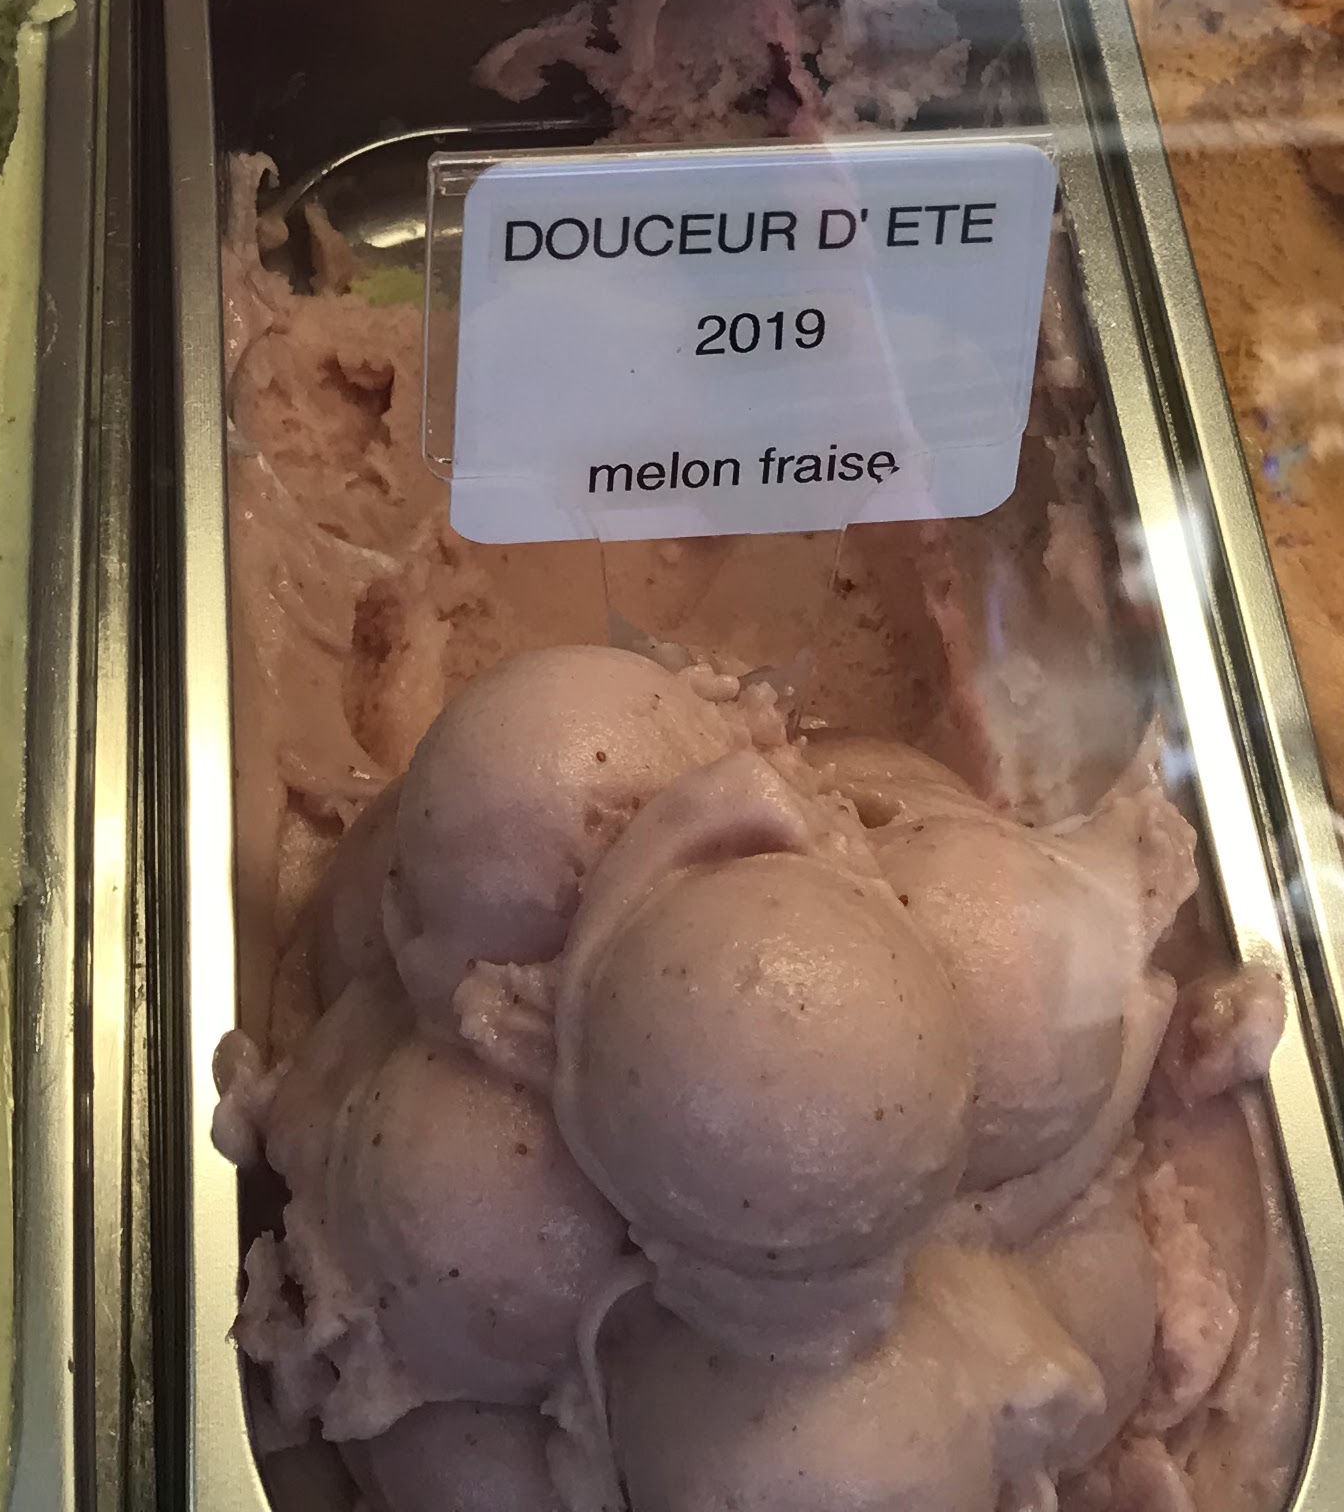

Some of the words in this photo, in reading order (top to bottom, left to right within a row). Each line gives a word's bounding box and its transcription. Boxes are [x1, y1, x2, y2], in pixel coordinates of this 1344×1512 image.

[504, 209, 797, 262] DOUCEUR
[817, 207, 869, 251] D'
[885, 202, 998, 247] ETE
[694, 308, 826, 356] 2019
[588, 451, 741, 493] melon
[759, 445, 900, 486] fraise
